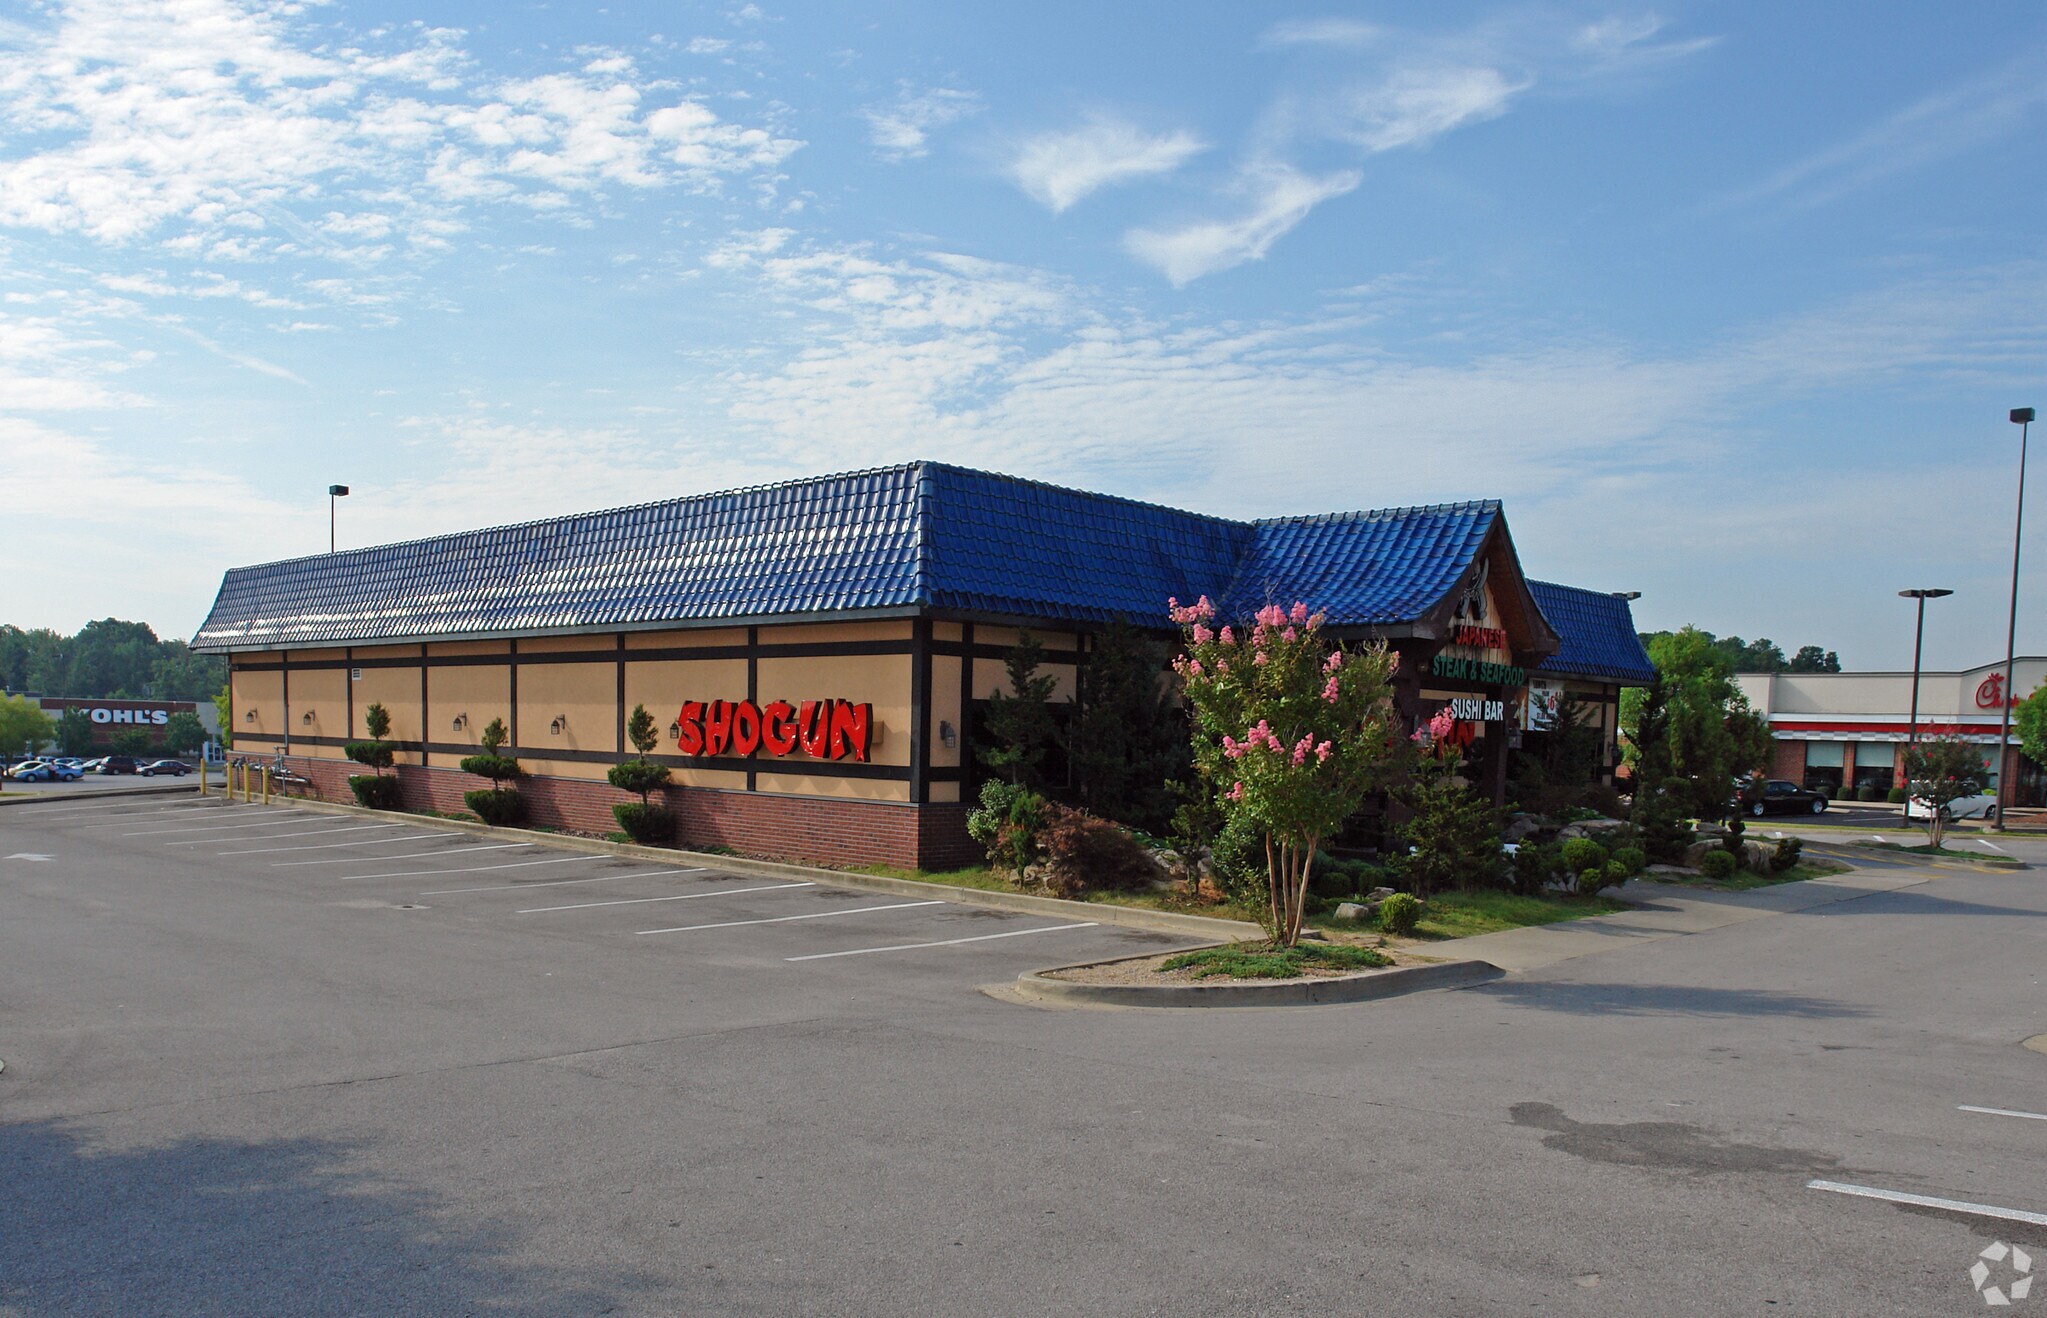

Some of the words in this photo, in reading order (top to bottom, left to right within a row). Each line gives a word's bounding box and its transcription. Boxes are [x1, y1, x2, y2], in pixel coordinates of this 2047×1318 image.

[1456, 625, 1507, 650] JAPANESE
[1433, 655, 1467, 680] STEAK
[1470, 658, 1477, 680] &
[1480, 662, 1525, 686] SEAFOOD
[71, 708, 169, 725] OHL'S
[1451, 698, 1482, 720] SUSHI
[1484, 701, 1504, 721] BAR
[678, 699, 873, 763] SHOGUN
